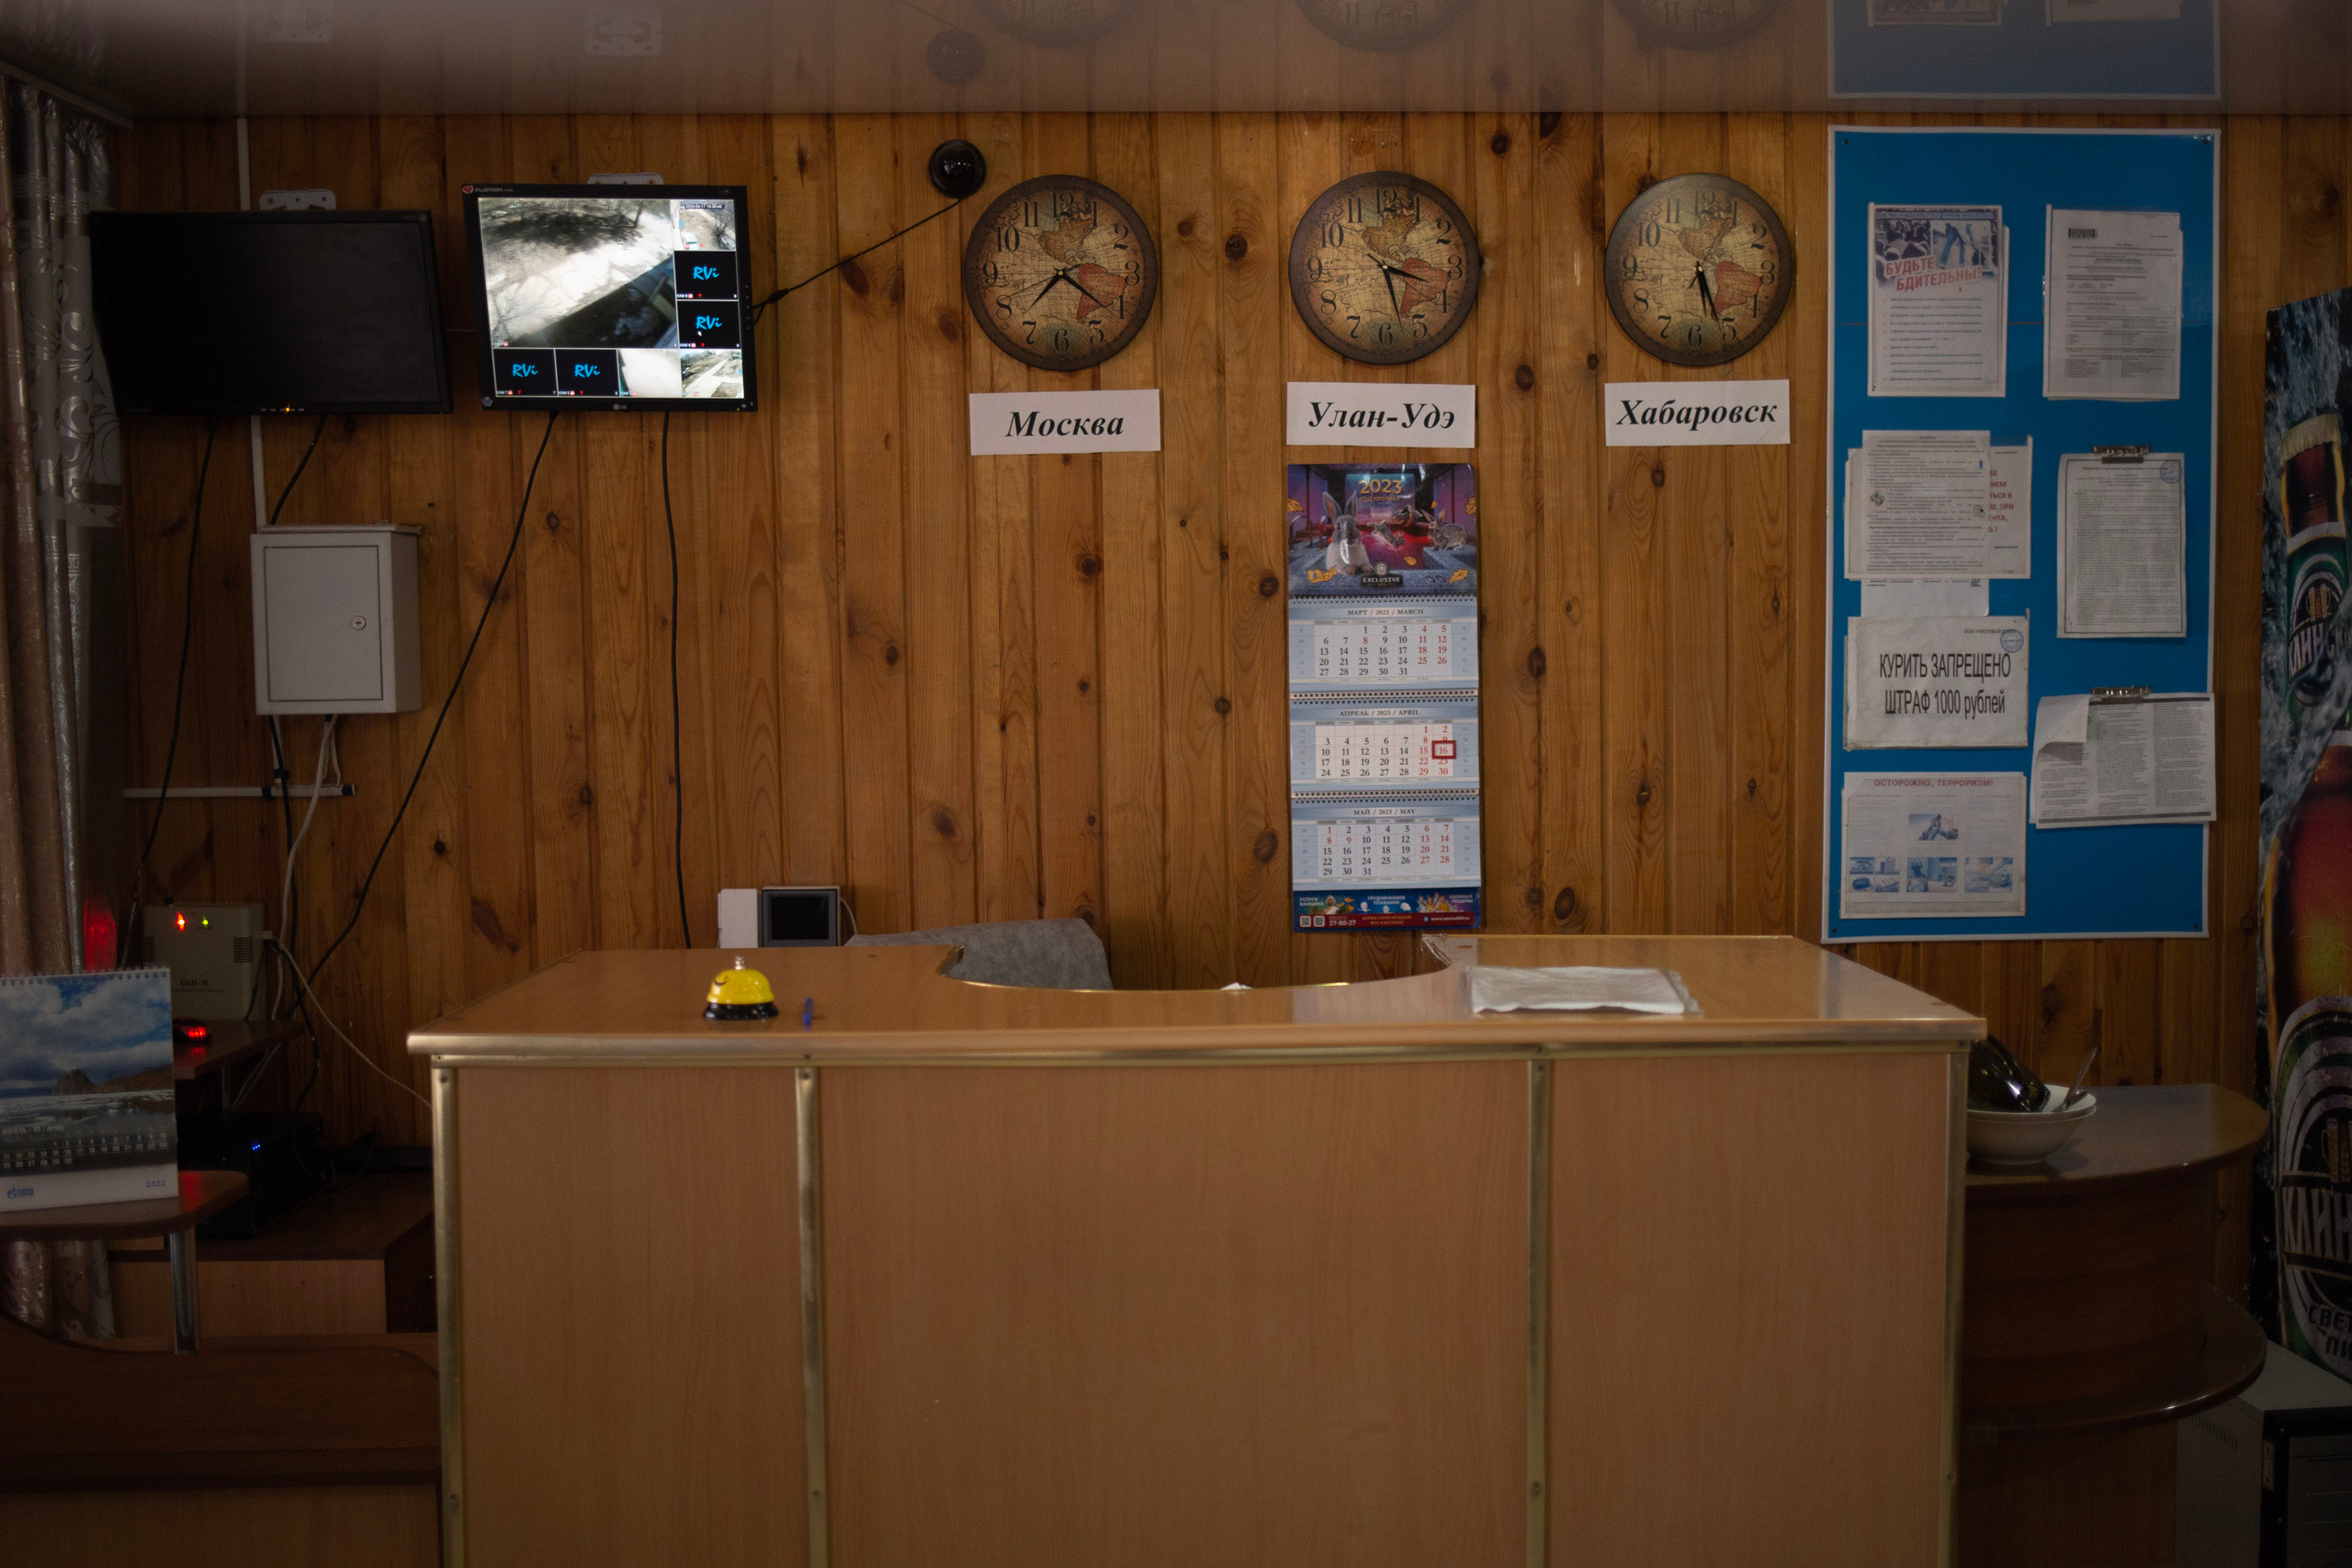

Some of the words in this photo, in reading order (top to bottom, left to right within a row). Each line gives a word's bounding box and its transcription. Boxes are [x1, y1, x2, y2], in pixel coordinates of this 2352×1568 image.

[1052, 191, 1075, 218] 12
[1348, 198, 1362, 223] 11
[1376, 188, 1398, 214] 12
[1415, 197, 1421, 222] 1
[1666, 198, 1680, 224] 11
[1695, 190, 1716, 216] 12
[1731, 200, 1738, 225] 1
[1024, 201, 1038, 227] 11
[1092, 201, 1098, 227] 1
[997, 227, 1020, 252] 10
[1114, 225, 1130, 250] 2
[1321, 222, 1344, 248] 10
[1437, 220, 1452, 244] 2
[1638, 221, 1661, 247] 10
[1752, 225, 1766, 249] 2
[982, 261, 999, 285] 9
[1124, 261, 1140, 286] 3
[1307, 256, 1323, 281] 9
[1447, 255, 1462, 280] 3
[1622, 255, 1638, 279] 9
[1760, 261, 1775, 286] 3
[1885, 257, 1935, 275] БУДЬТЕ
[1896, 266, 1982, 291] БДИТЕЛЬНЫ!
[996, 295, 1013, 320] 8
[1112, 295, 1128, 320] 4
[1321, 290, 1337, 315] 8
[1435, 289, 1450, 313] 4
[1633, 288, 1649, 314] 8
[1747, 294, 1761, 318] 4
[1022, 321, 1036, 345] 7
[1089, 320, 1104, 345] 5
[1347, 315, 1360, 339] 7
[1378, 323, 1393, 347] 6
[1412, 314, 1427, 339] 5
[1658, 315, 1671, 338] 7
[1687, 325, 1702, 349] 6
[1722, 317, 1737, 342] 5
[1054, 328, 1069, 354] 6
[1005, 411, 1124, 437] Москва
[1308, 402, 1455, 429] Улан-Удэ
[1616, 399, 1778, 432] Хабаровск
[1359, 479, 1402, 494] 2023
[1320, 647, 1329, 655] 13
[1340, 647, 1348, 655] 14
[1399, 646, 1407, 654] 17
[1438, 645, 1447, 654] 19
[1419, 635, 1426, 643] 11
[1438, 635, 1447, 643] 12
[1319, 658, 1329, 666] 20
[1358, 657, 1368, 666] 22
[1379, 657, 1388, 666] 23
[1418, 656, 1427, 665] 25
[1437, 656, 1447, 665] 26
[1379, 667, 1389, 676] 30
[1880, 654, 1928, 678] КУРИТЬ
[1931, 653, 2011, 683] ЗАПРЕЩЕНО
[1885, 690, 1930, 714] ШТРАФ
[1935, 690, 1961, 713] 1000
[1965, 690, 2005, 719] рублей
[1322, 758, 1330, 767] 17
[1342, 758, 1350, 767] 18
[1380, 757, 1390, 766] 20
[1400, 757, 1408, 766] 21
[1361, 747, 1369, 756] 12
[1380, 747, 1390, 756] 13
[1420, 746, 1428, 755] 15
[1439, 746, 1448, 755] 16
[1360, 768, 1370, 777] 26
[1380, 768, 1390, 777] 27
[1419, 767, 1429, 776] 29
[1438, 767, 1448, 776] 30
[1874, 779, 1933, 787] ОСТОРОЖНО,
[1938, 778, 1993, 787] ТЕРРОРИЗМ!
